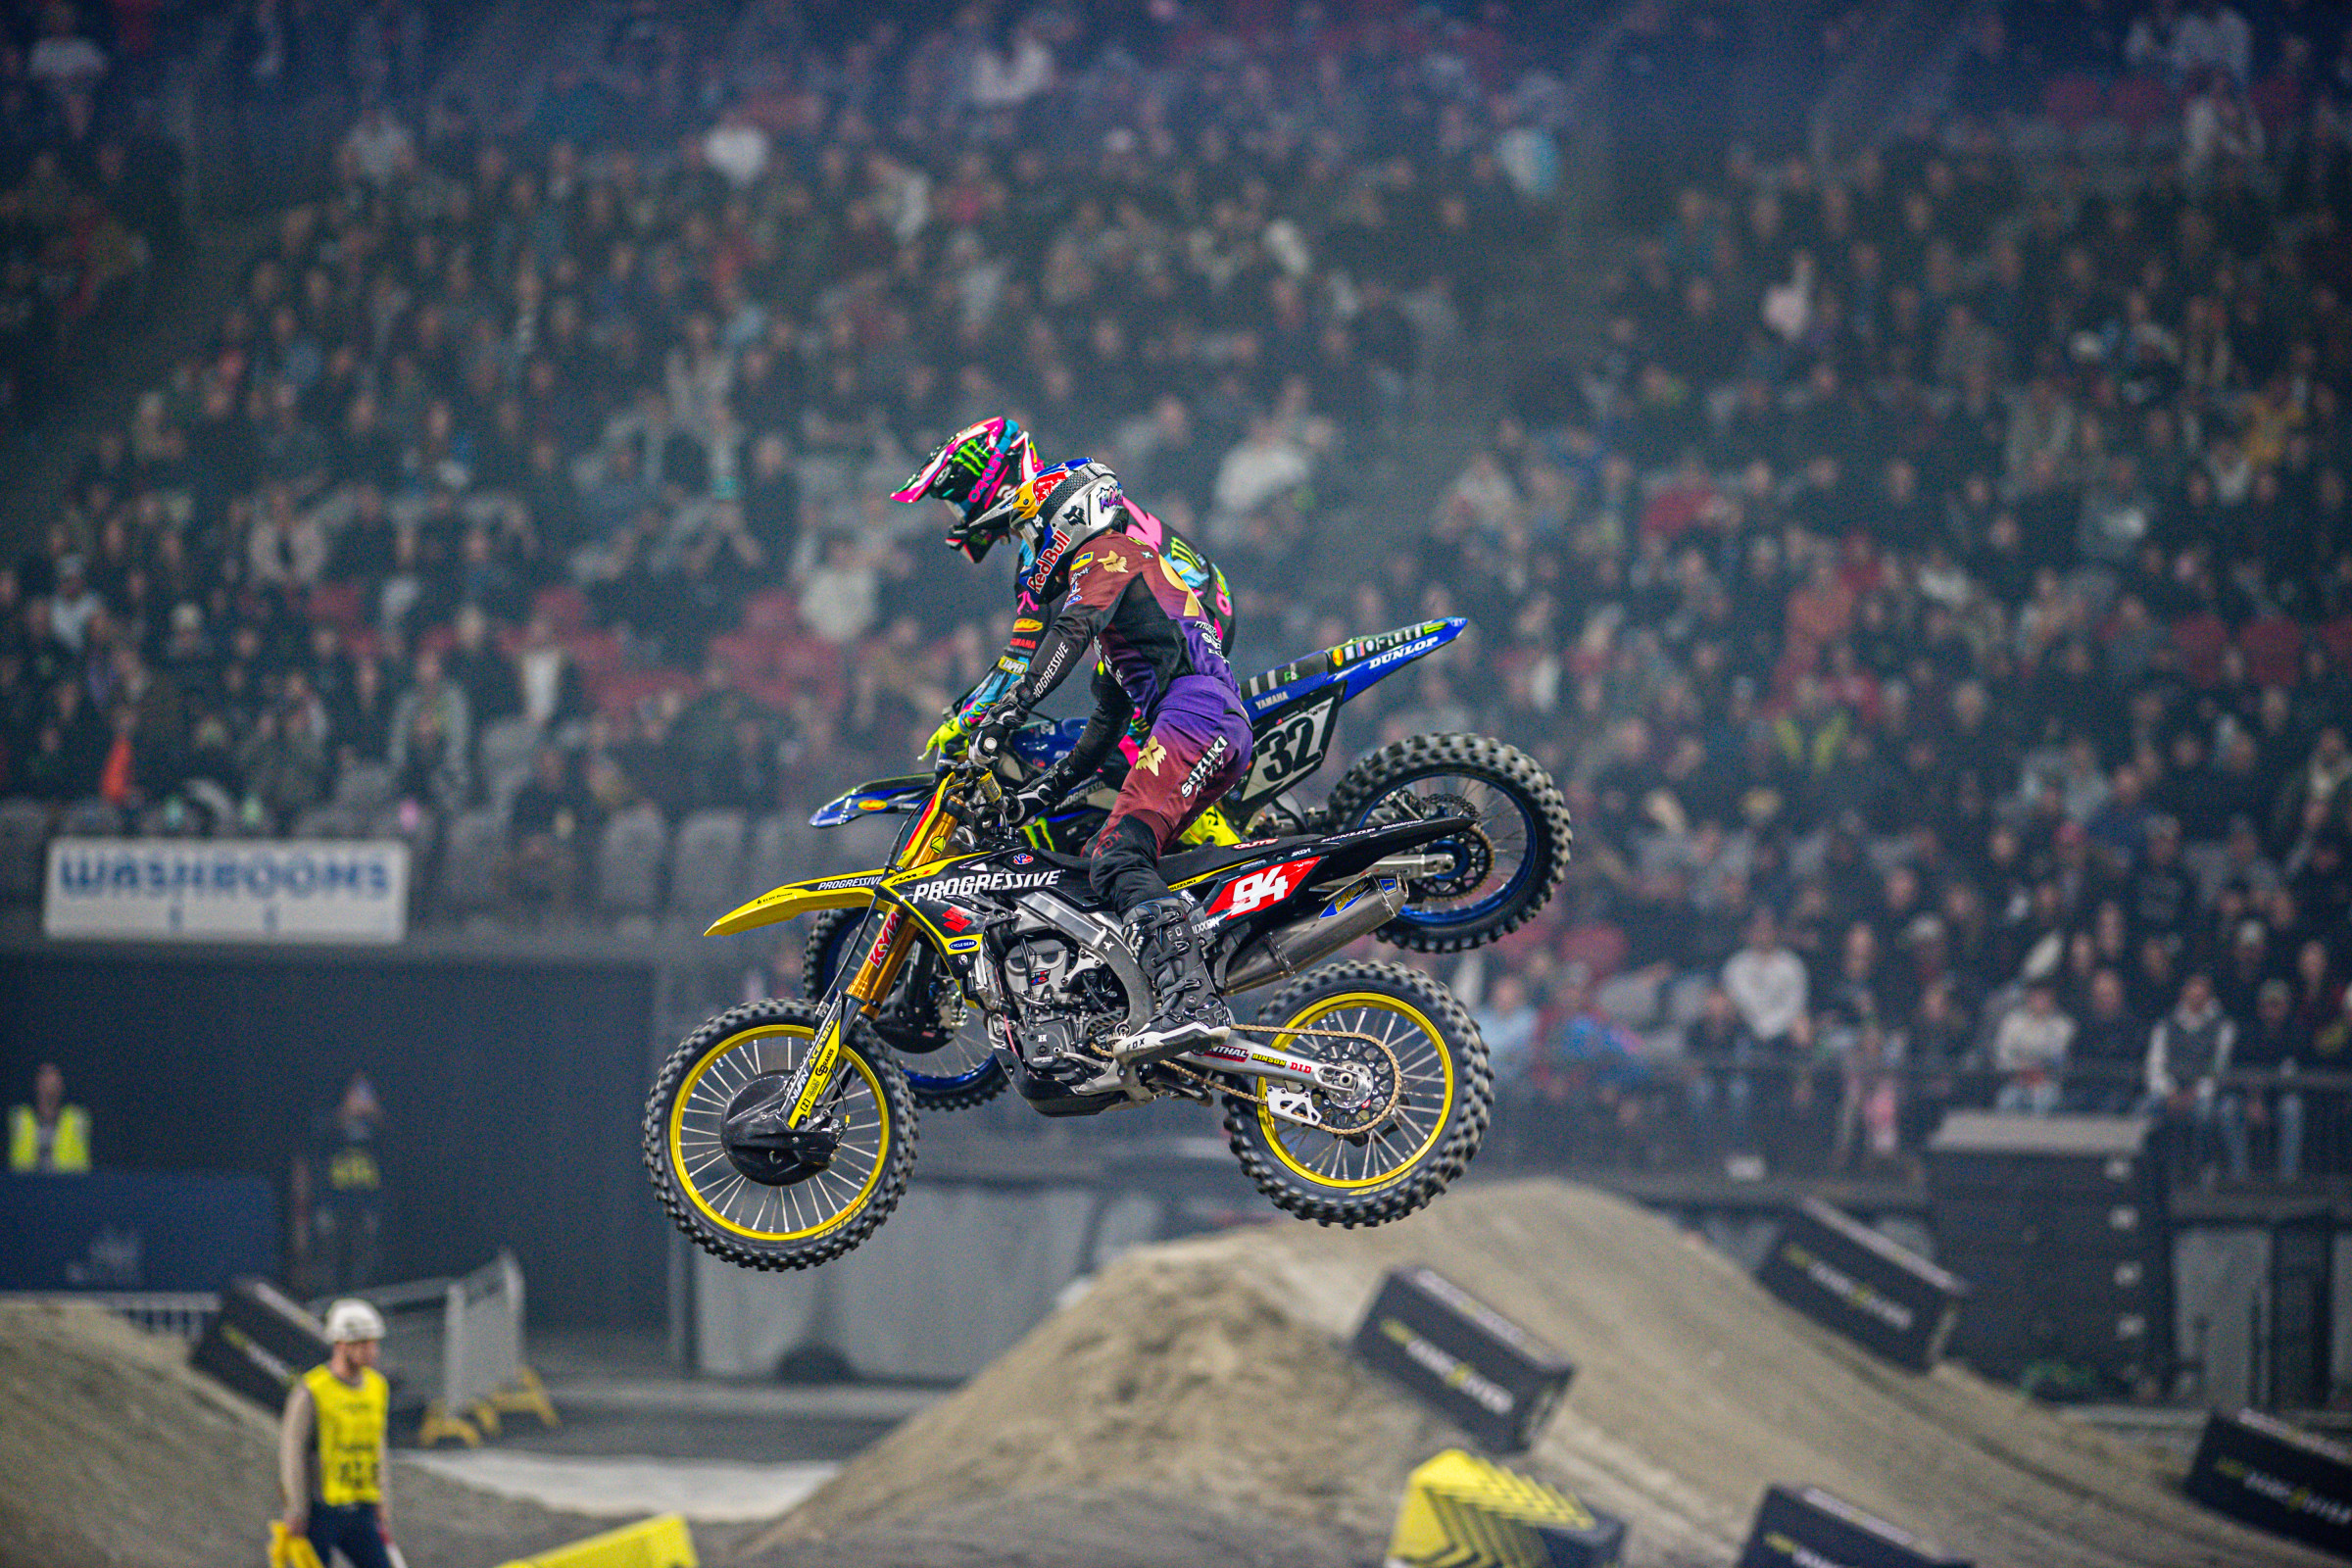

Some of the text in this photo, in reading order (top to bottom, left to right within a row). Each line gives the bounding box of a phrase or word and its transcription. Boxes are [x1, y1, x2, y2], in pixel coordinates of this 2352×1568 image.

[1002, 659, 1025, 674] TAPER
[1369, 636, 1439, 669] DUNLOP
[1255, 691, 1290, 710] YAMAHA
[1257, 716, 1321, 782] 32
[1181, 735, 1228, 798] SUZUKI
[1098, 830, 1123, 858] FOX
[59, 854, 391, 899] WASHROOMS
[817, 876, 882, 891] PROGRESSIVE
[911, 869, 1061, 904] PROGRESSIVE
[1231, 865, 1289, 916] 94
[868, 911, 903, 969] KYB
[1208, 1045, 1249, 1058] NTHAL
